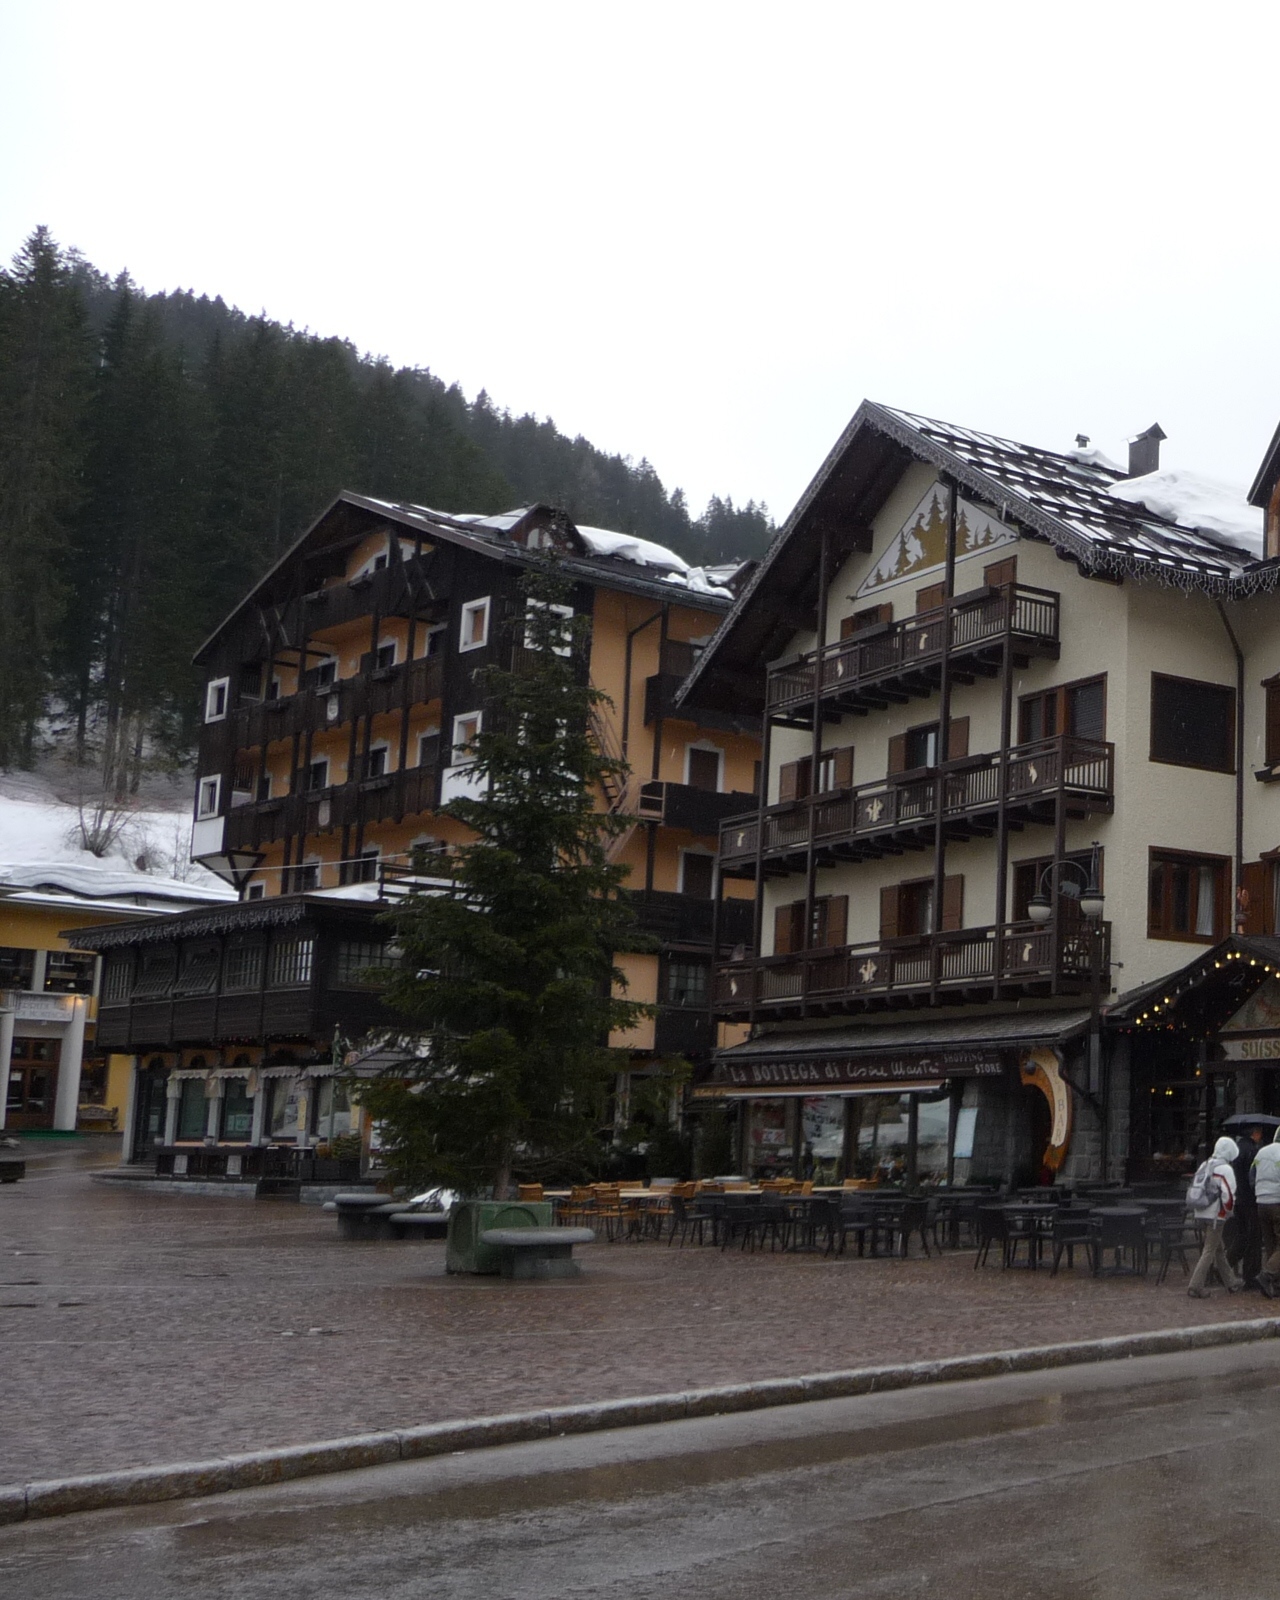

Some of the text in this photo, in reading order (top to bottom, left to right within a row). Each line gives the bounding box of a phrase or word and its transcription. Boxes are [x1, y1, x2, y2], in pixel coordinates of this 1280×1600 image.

[944, 1051, 984, 1064] SHOPPING
[752, 1062, 820, 1081] BOTTEGA
[825, 1062, 840, 1079] di
[974, 1062, 1002, 1075] STORE
[1056, 1098, 1065, 1142] BAR
